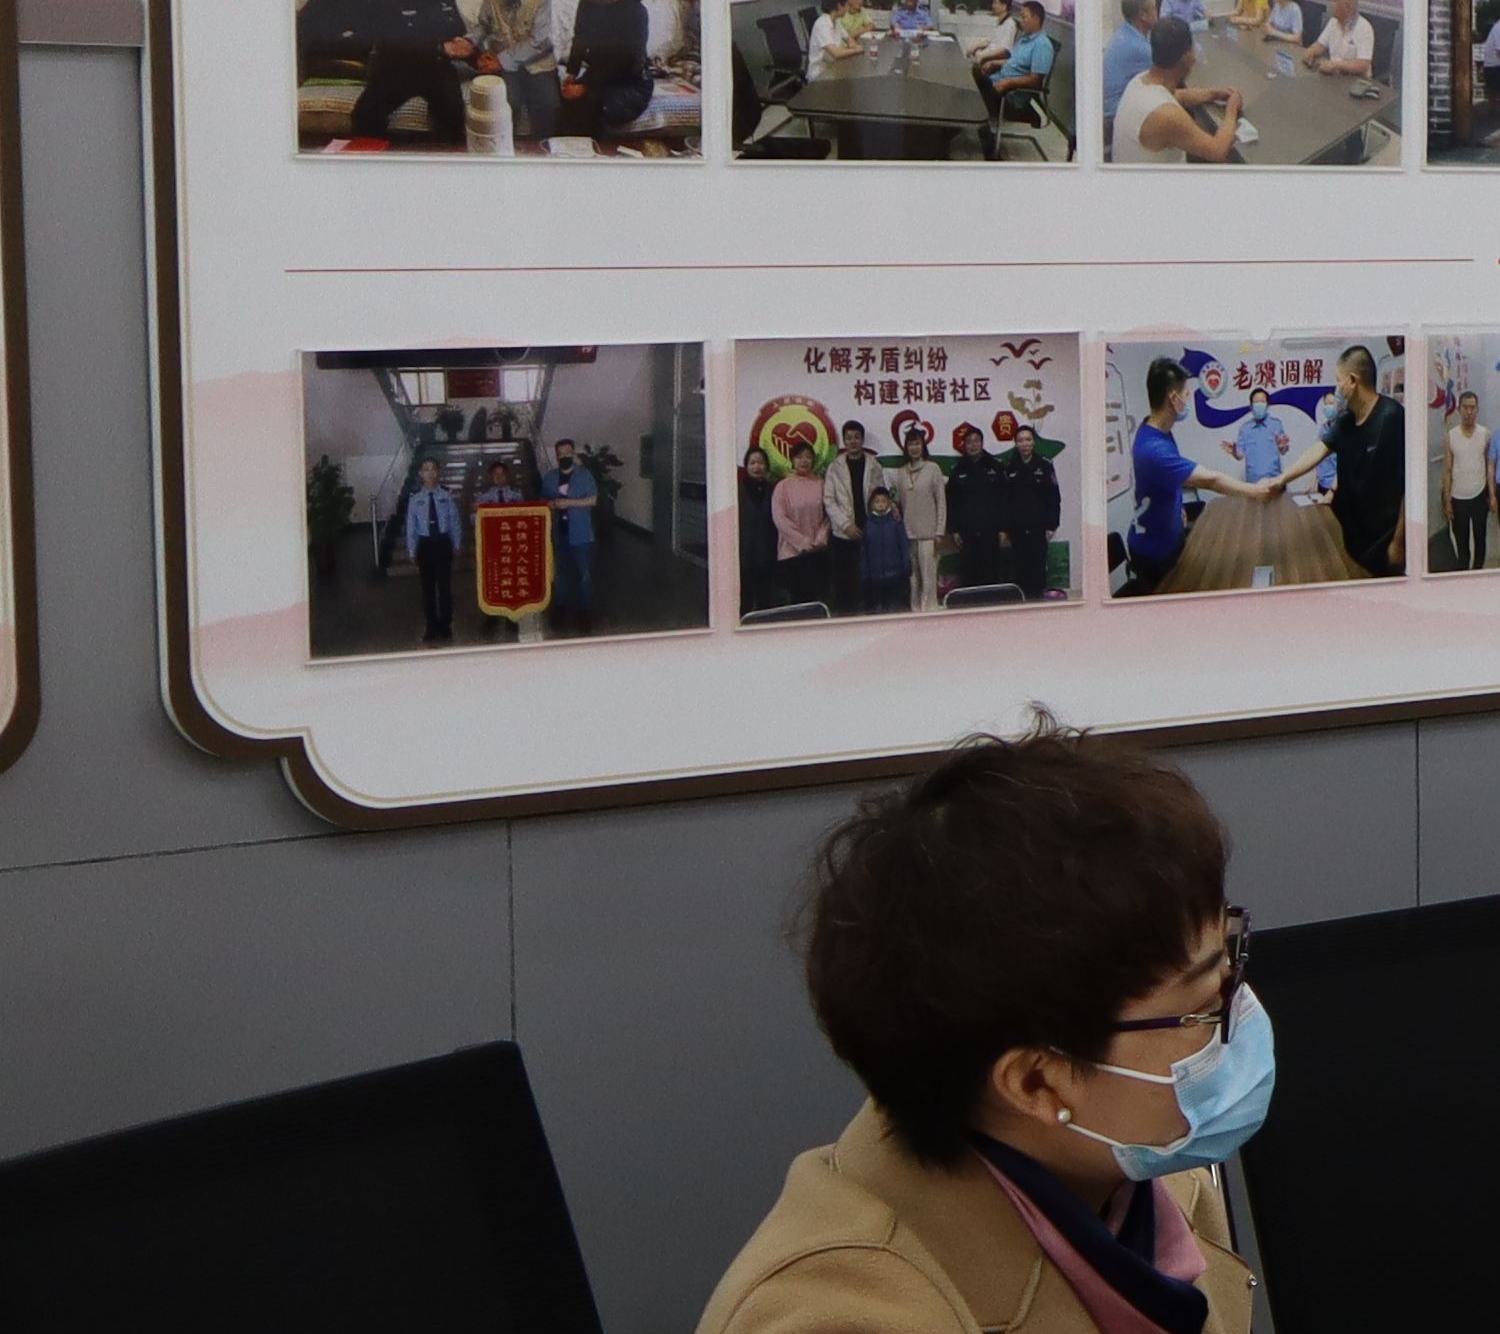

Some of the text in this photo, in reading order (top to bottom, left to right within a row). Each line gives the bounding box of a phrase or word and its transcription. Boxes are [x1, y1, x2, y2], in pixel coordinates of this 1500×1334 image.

[804, 347, 948, 373] 化解矛盾纠纷
[854, 377, 991, 405] 构建和谐社区
